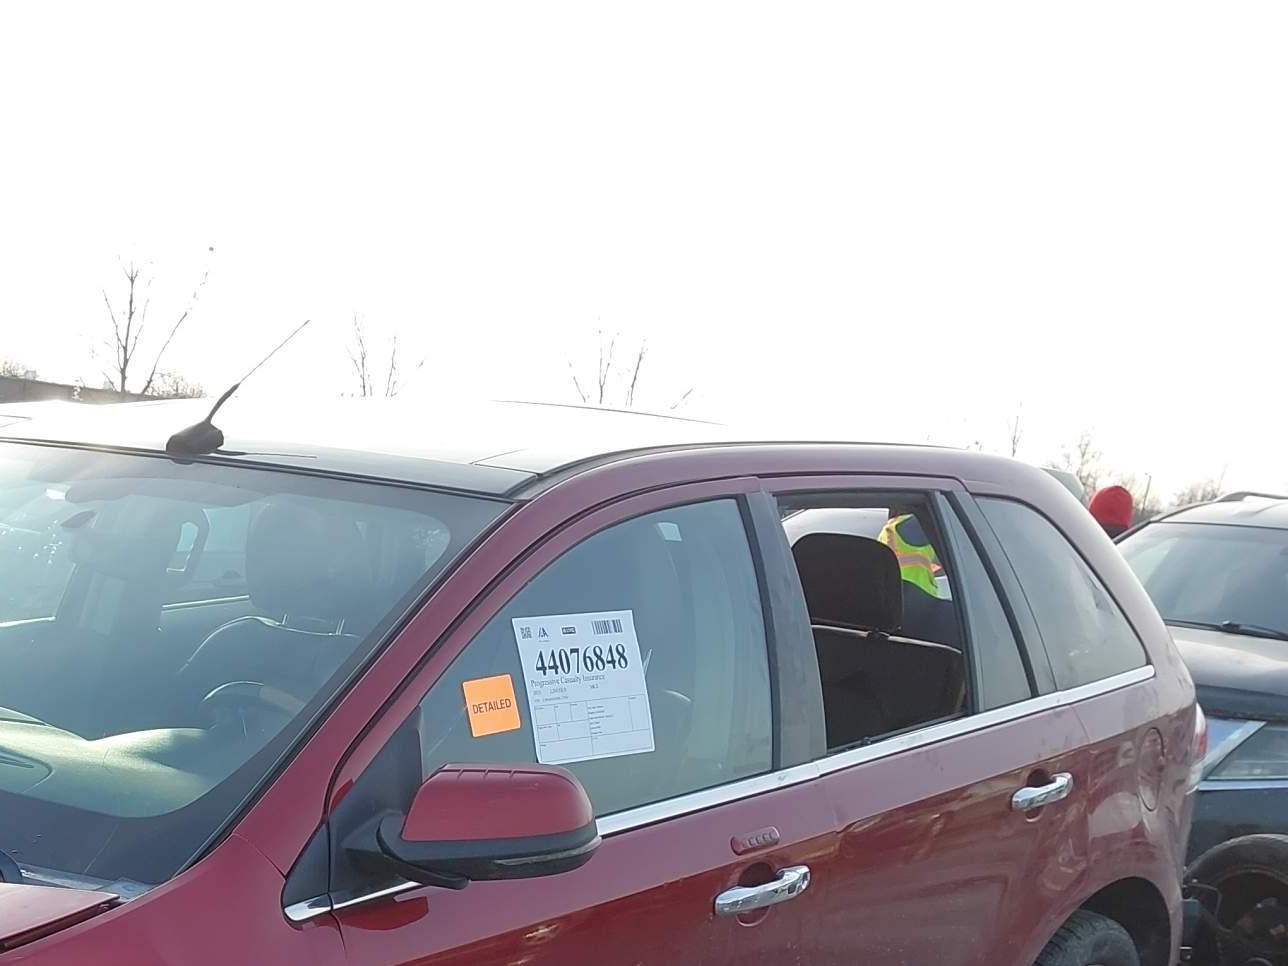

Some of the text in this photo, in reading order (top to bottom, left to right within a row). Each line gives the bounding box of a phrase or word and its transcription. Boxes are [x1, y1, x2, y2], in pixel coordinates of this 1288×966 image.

[535, 643, 628, 676] 44076848
[530, 673, 605, 688] Progressive Casualty Insurance
[472, 698, 512, 714] DETAILED
